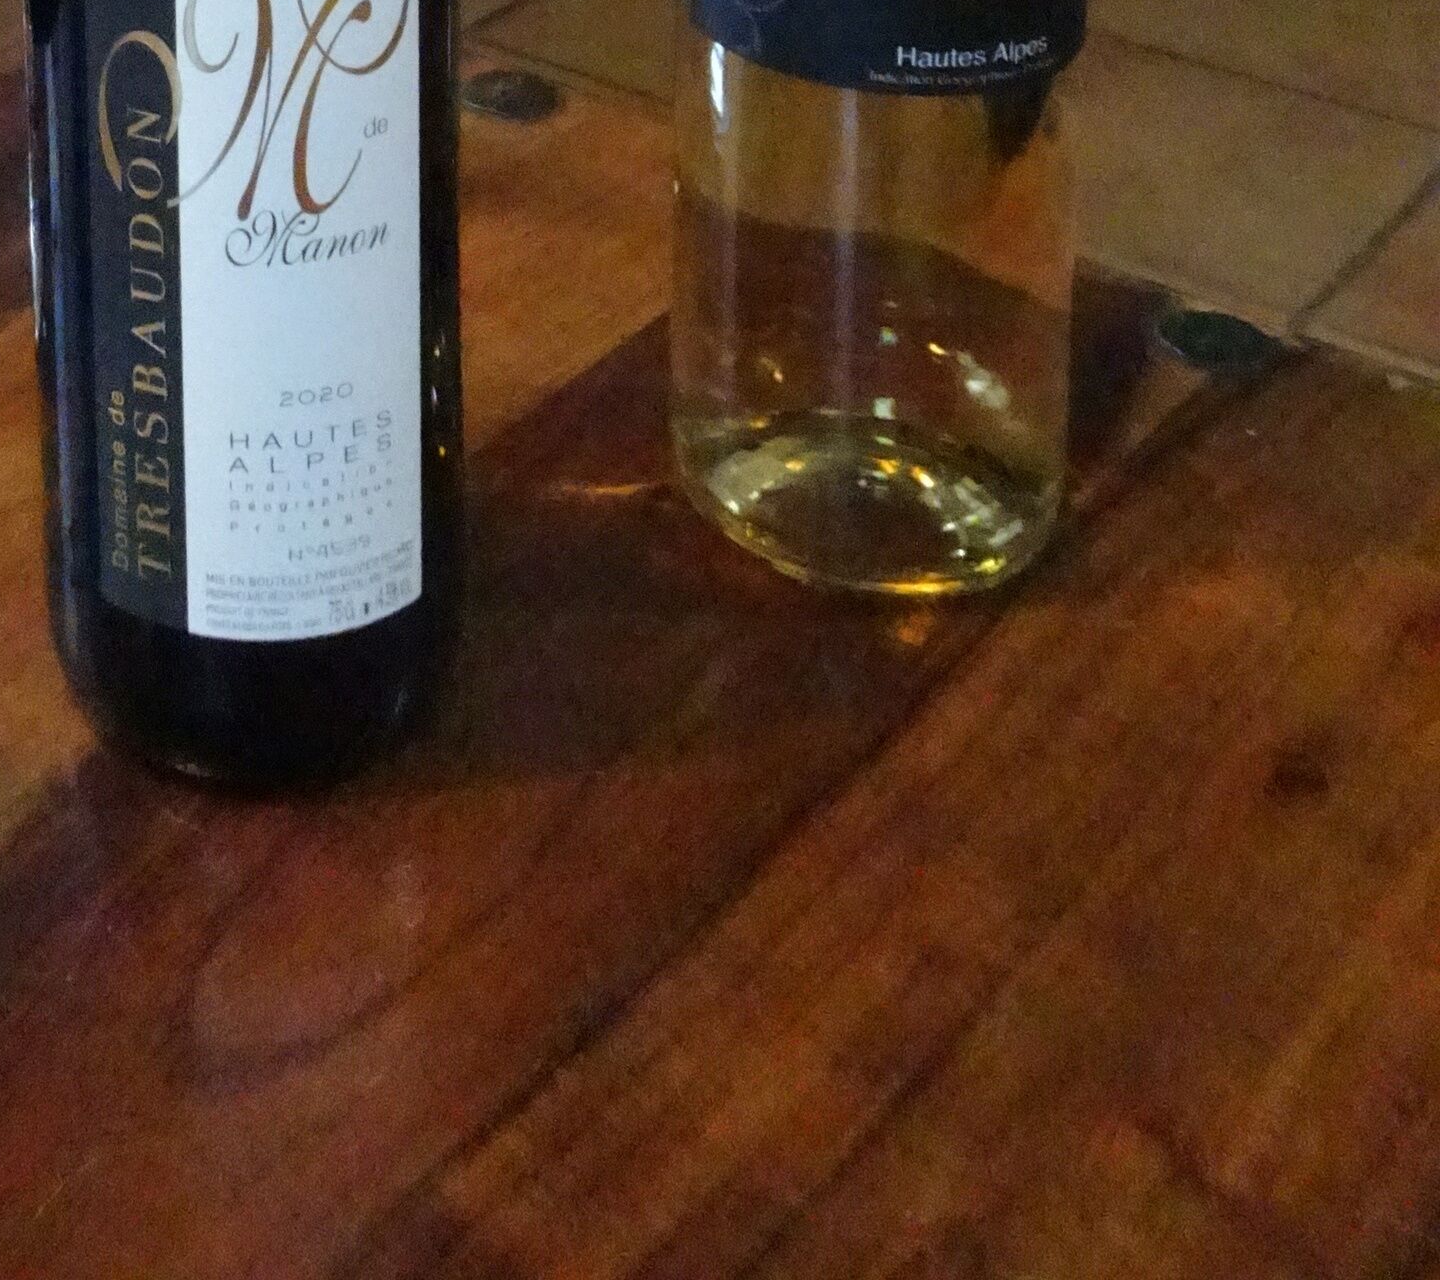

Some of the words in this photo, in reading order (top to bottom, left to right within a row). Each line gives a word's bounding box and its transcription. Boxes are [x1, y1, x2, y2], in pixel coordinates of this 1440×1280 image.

[896, 45, 987, 68] Hautes
[992, 36, 1049, 64] Alpes
[363, 116, 388, 138] de
[225, 210, 388, 268] Manon
[126, 108, 172, 579] TRESBAUDON
[108, 390, 126, 426] de
[279, 383, 353, 408] 2020
[229, 409, 393, 450] HAUTES
[229, 432, 393, 474] ALPES
